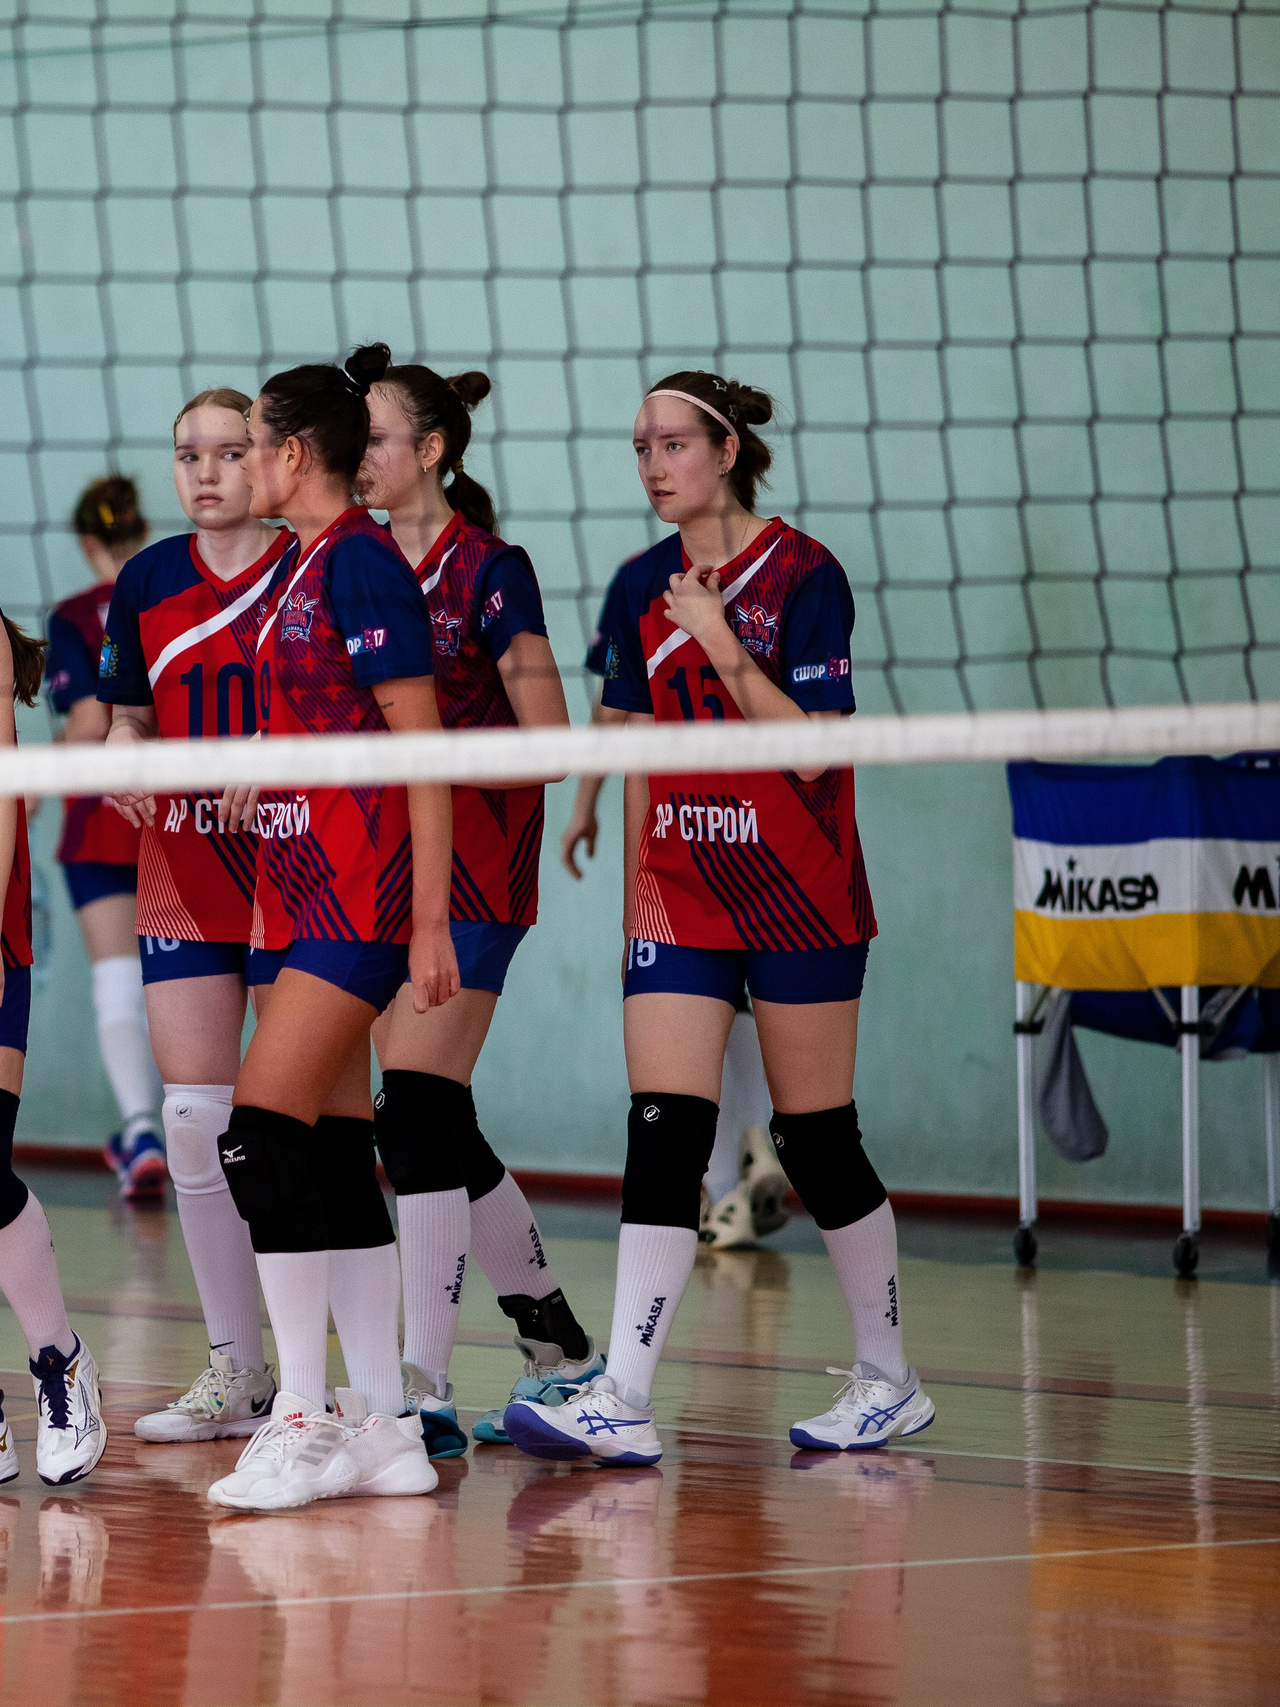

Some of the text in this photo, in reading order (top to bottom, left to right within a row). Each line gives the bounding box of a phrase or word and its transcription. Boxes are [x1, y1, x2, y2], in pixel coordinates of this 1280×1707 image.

[490, 591, 503, 611] 17
[373, 629, 385, 647] 17
[793, 659, 849, 682] СШОР 17
[180, 662, 256, 741] 10
[163, 799, 187, 833] АР
[257, 795, 310, 839] СТРОЙ
[652, 801, 759, 843] АР СТРОЙ
[529, 1222, 547, 1270] MIKASA
[447, 1253, 466, 1304] MIKASA
[886, 1274, 899, 1327] MIKASA
[638, 1296, 667, 1347] MIKASA
